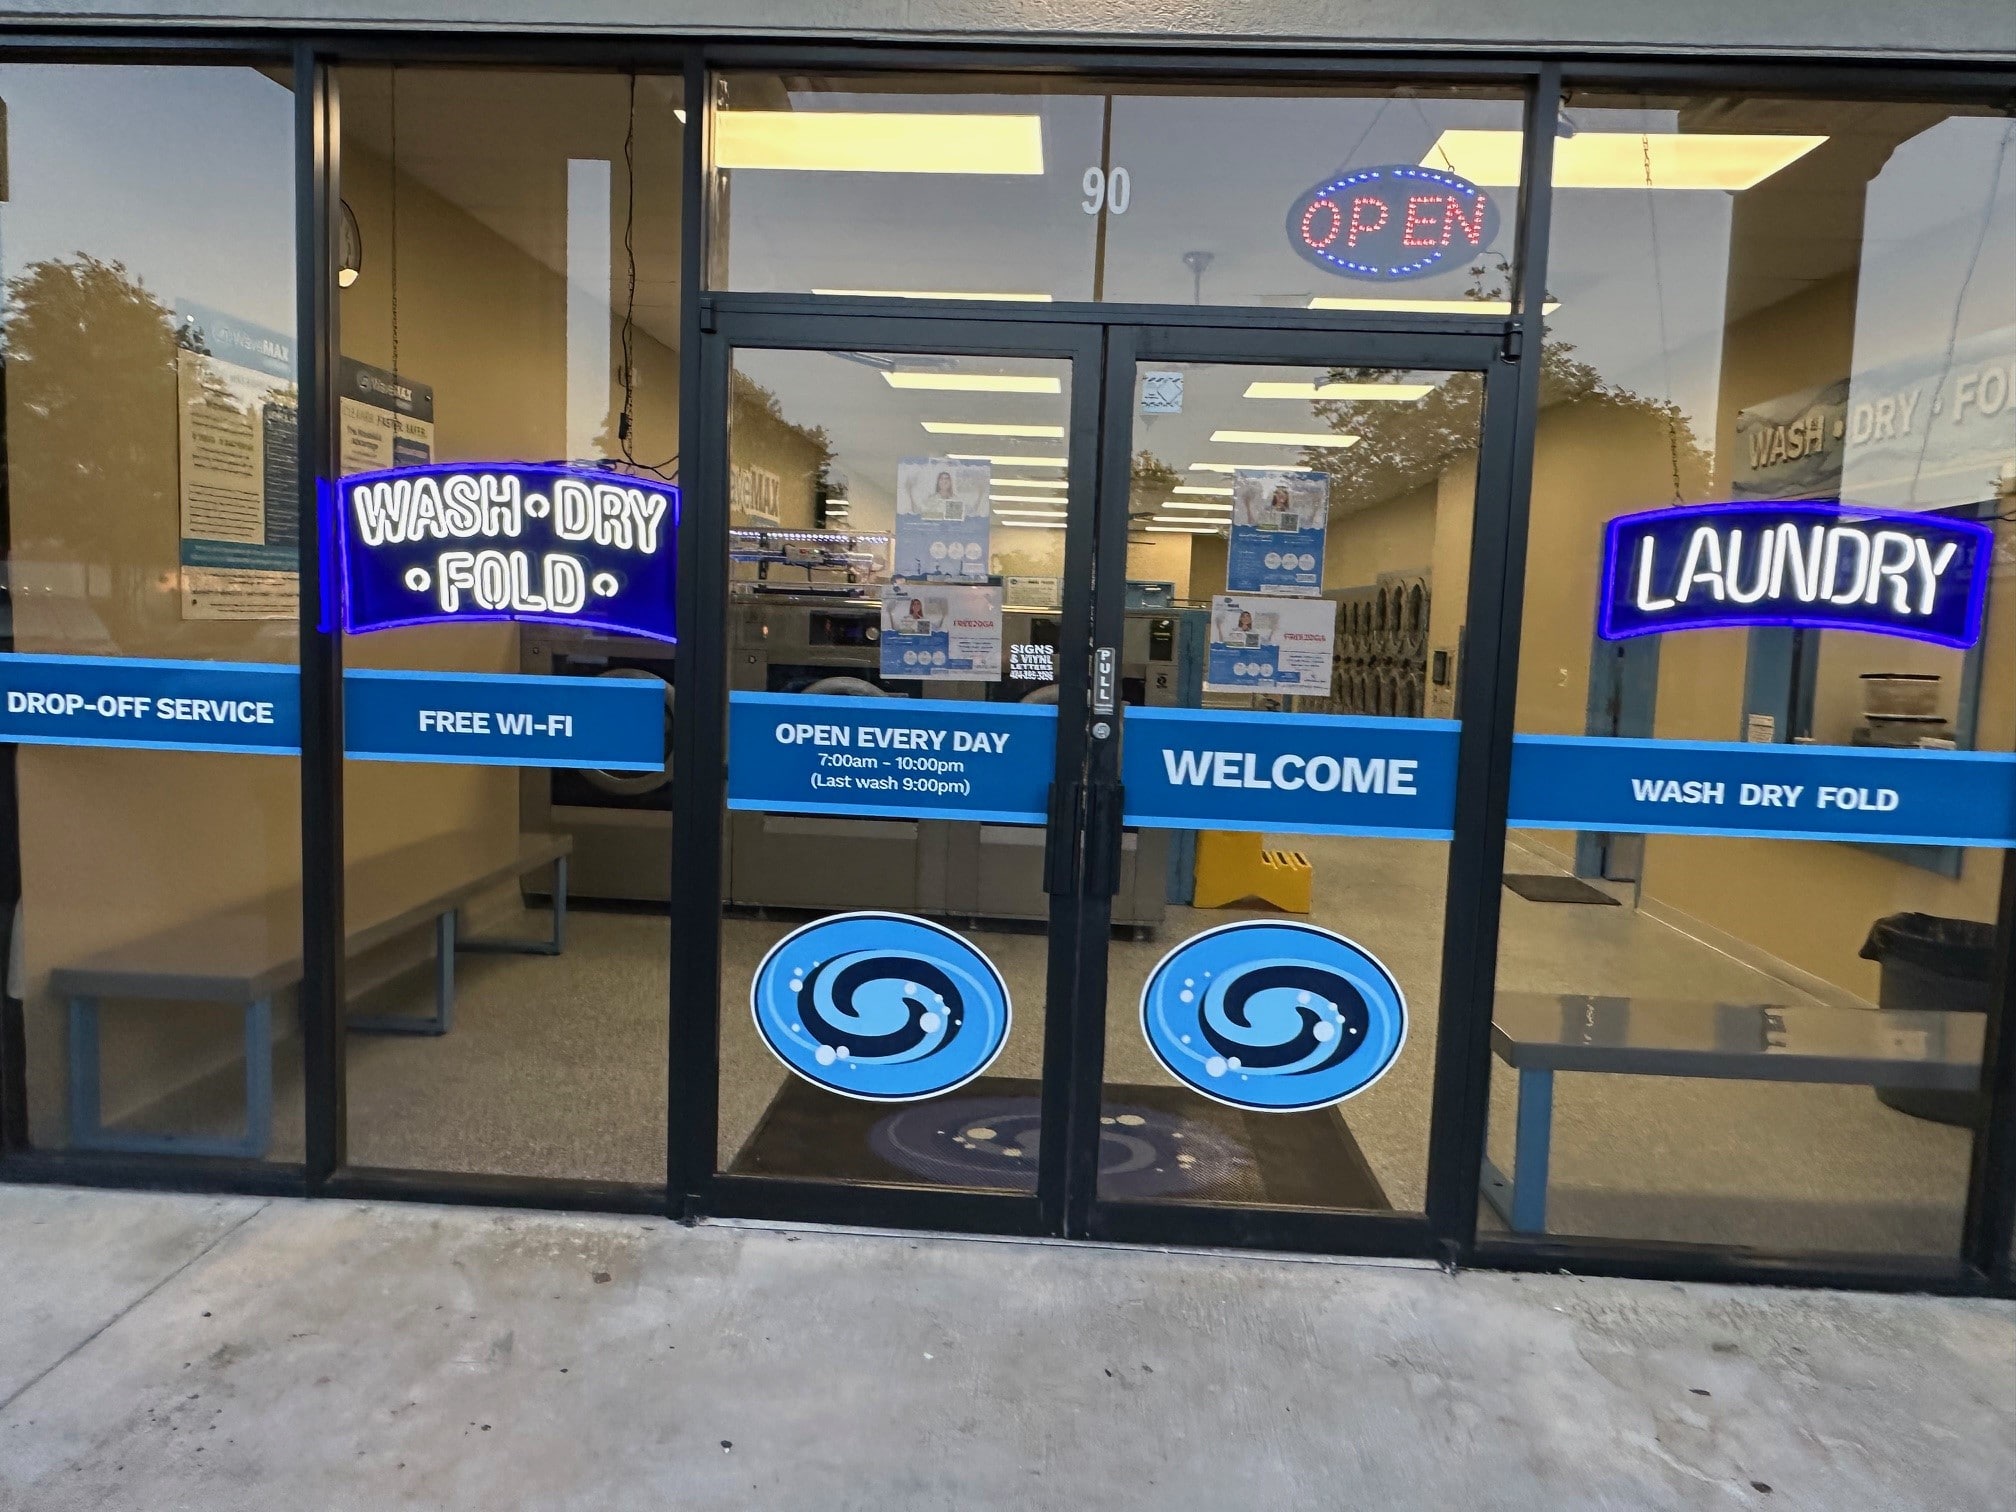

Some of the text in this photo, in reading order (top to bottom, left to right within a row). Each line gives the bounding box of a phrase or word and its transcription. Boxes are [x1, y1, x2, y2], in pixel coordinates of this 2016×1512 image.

[1081, 166, 1131, 215] 90
[1302, 195, 1487, 248] OPEN
[1750, 412, 1826, 470] WASH
[1851, 386, 1923, 446] DRY
[353, 474, 667, 554] WASH DRY
[438, 549, 586, 614] FOLD
[1636, 522, 1958, 616] LAUNDRY
[1010, 644, 1054, 655] SIGNS
[1099, 649, 1112, 701] PULL
[7, 691, 275, 724] DROP-OFF SERVICE
[418, 710, 573, 737] FREE WI-FI
[775, 723, 1010, 753] OPEN EVERY DAY
[810, 772, 971, 797] (Last wash 9:00pm)
[817, 752, 878, 769] 7:00am
[895, 755, 964, 775] 10:00pm
[1162, 748, 1419, 796] WELCOME
[1631, 778, 1900, 811] WASH DRY FOLD
